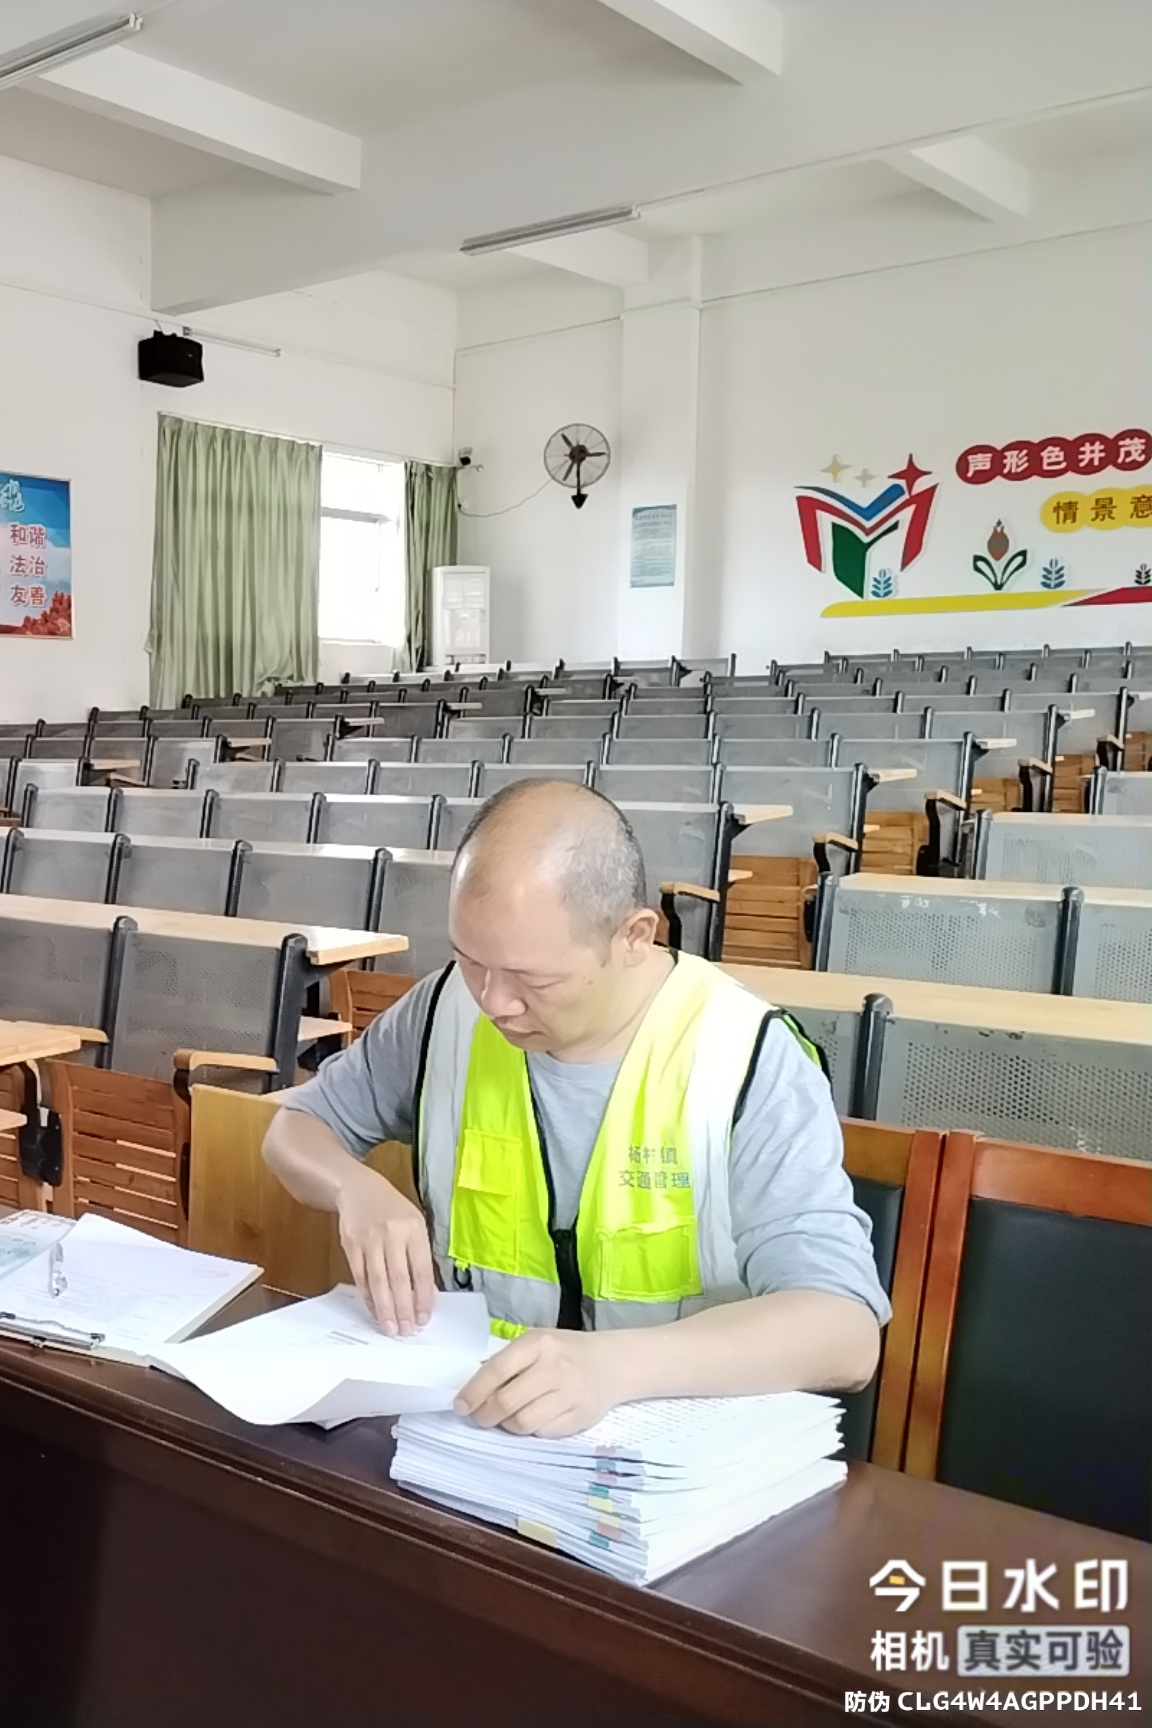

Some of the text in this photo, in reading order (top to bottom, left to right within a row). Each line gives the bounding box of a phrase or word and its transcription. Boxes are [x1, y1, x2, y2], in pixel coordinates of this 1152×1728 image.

[967, 437, 1147, 477] 声形色并茂
[10, 523, 47, 547] 和谐
[9, 554, 46, 577] 法治
[10, 584, 47, 607] 友善
[618, 1170, 691, 1190] 交通管理
